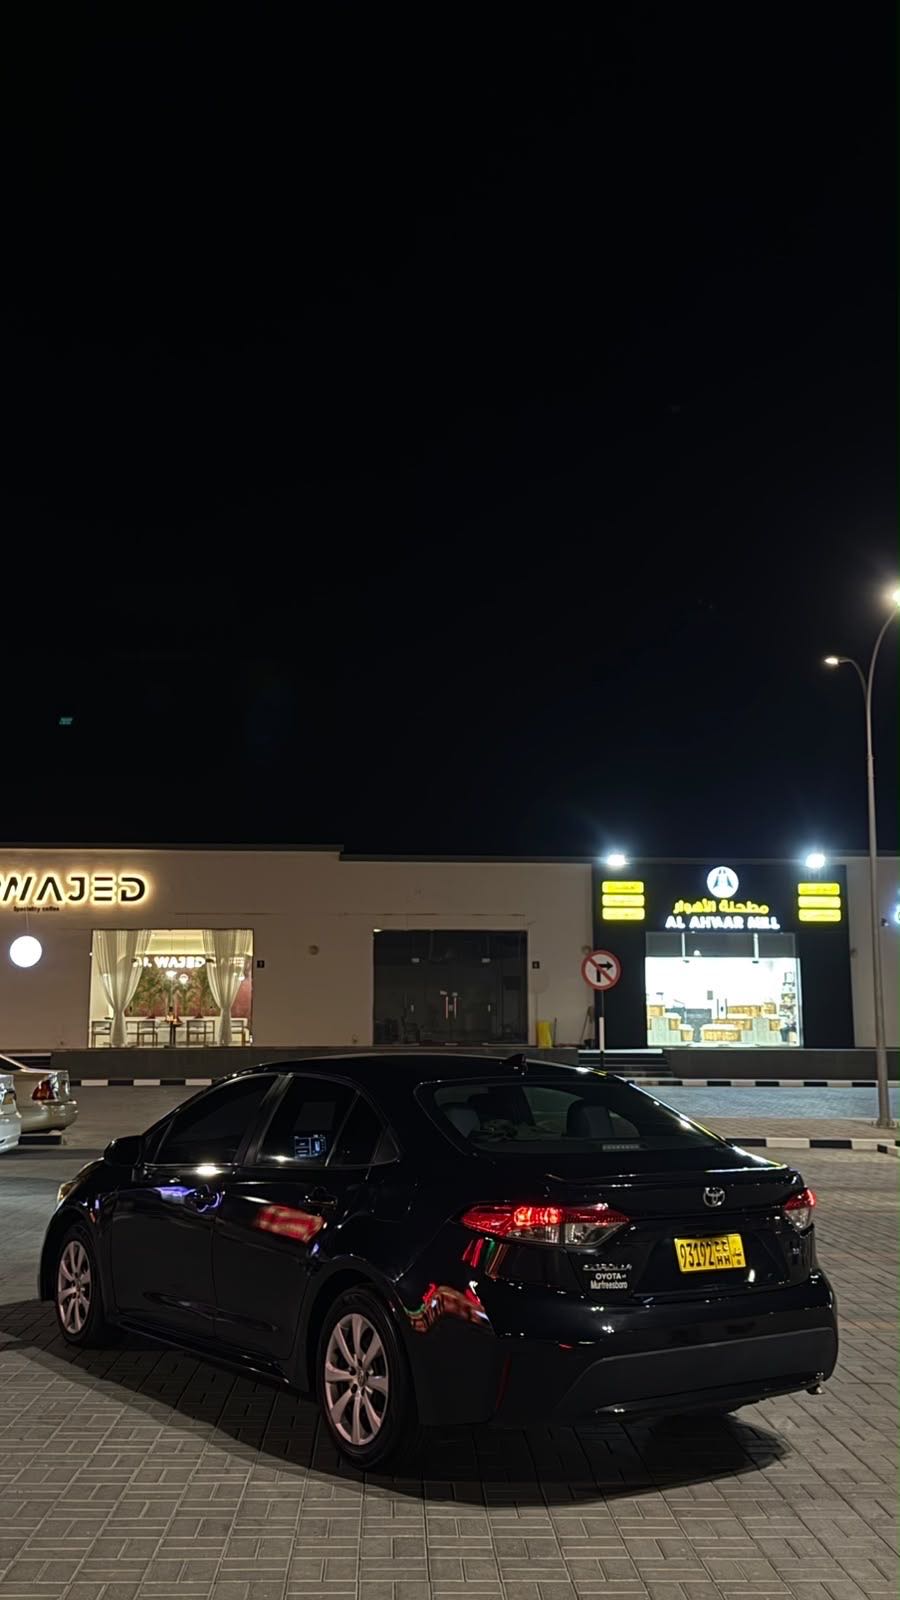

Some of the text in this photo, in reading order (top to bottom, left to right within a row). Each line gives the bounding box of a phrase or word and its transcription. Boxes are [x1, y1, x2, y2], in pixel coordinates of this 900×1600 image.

[664, 915, 686, 930] AL
[746, 915, 781, 930] MILL
[153, 956, 206, 968] WAJED
[679, 1241, 715, 1268] 93192
[716, 1254, 731, 1265] HH
[590, 1272, 621, 1280] OYOTA
